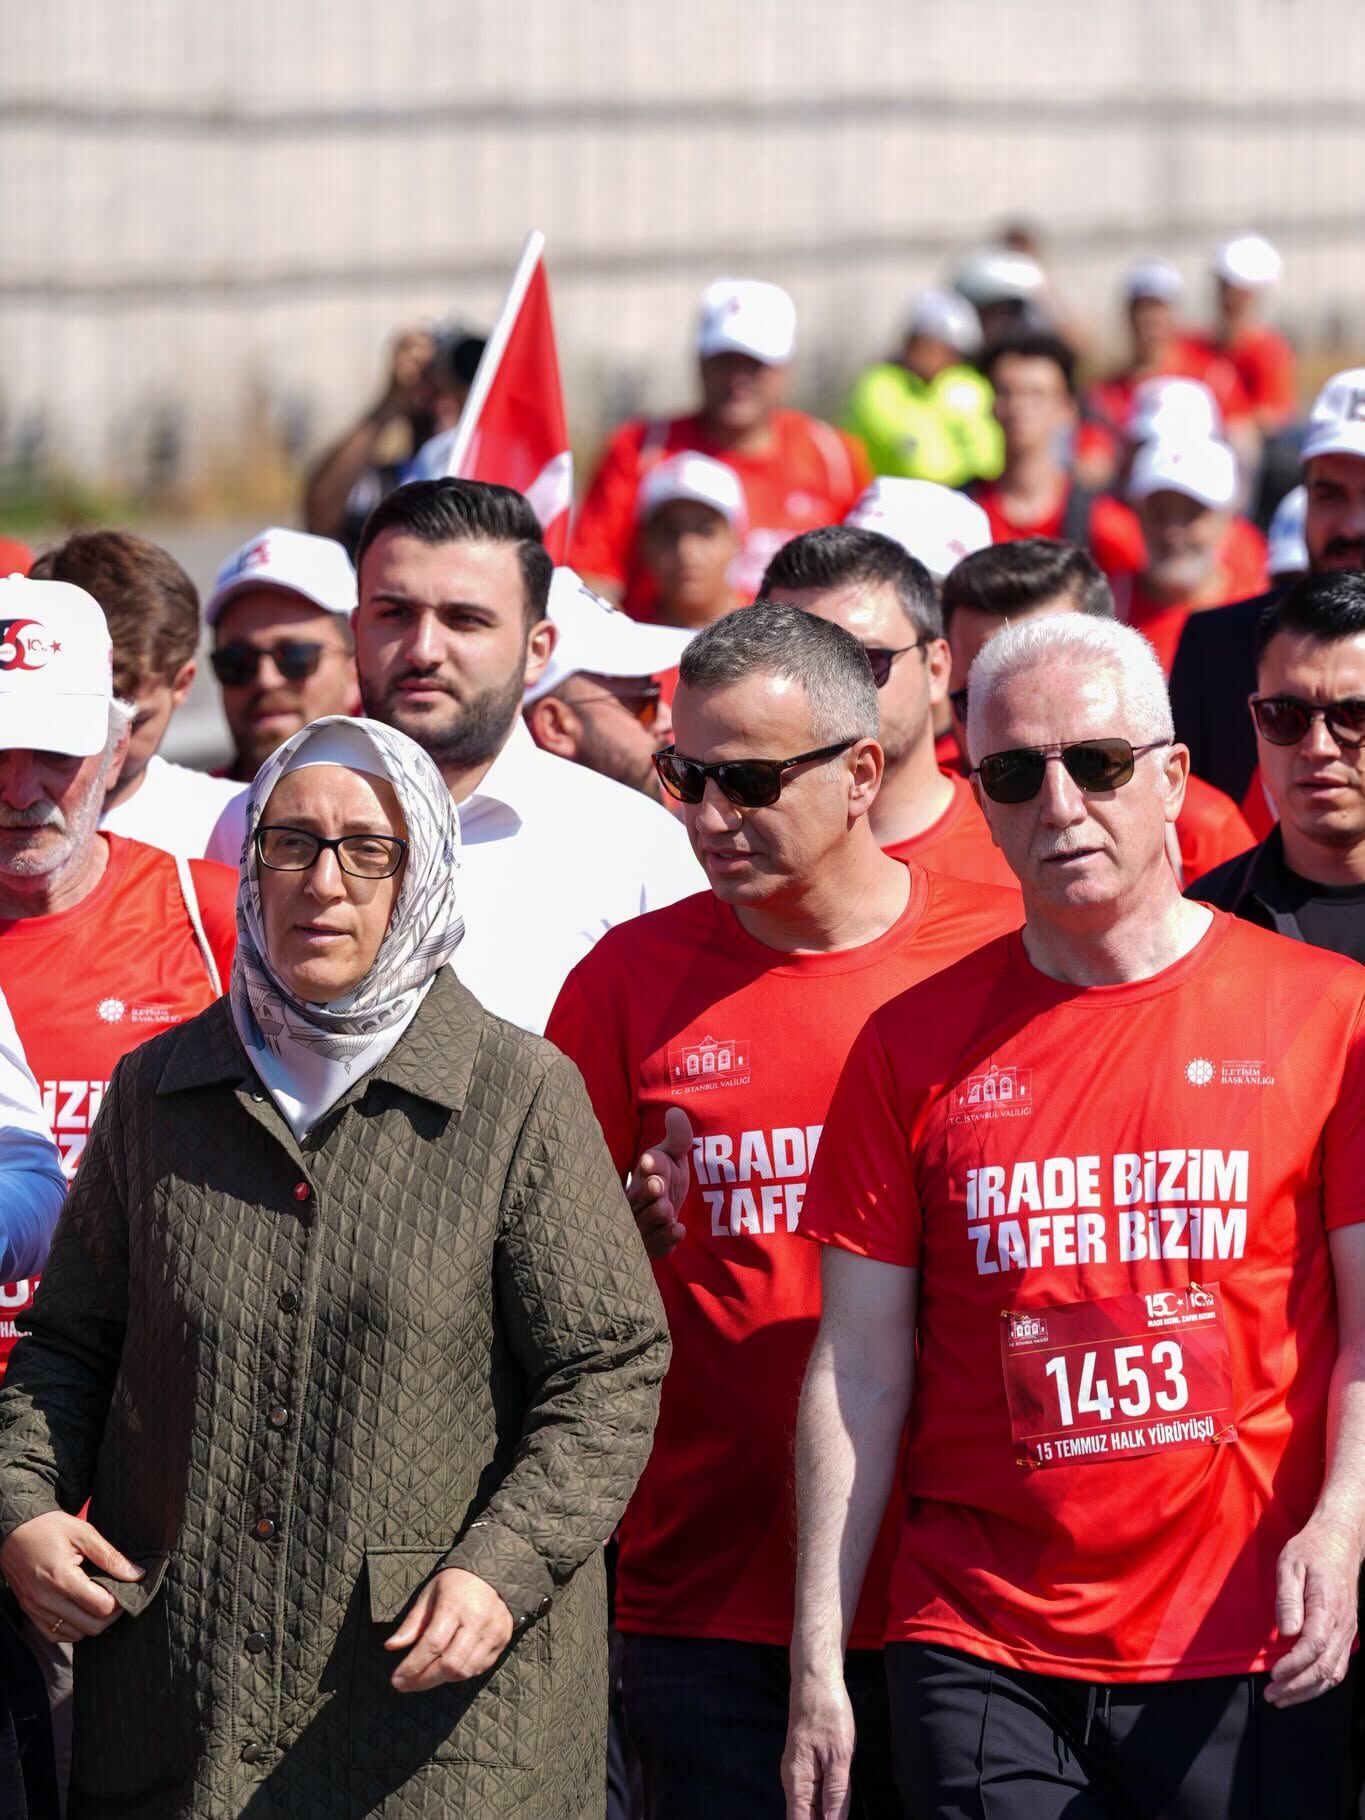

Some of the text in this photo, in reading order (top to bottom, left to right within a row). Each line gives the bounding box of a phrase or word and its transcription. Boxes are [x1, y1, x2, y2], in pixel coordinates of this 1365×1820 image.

[966, 1149, 1249, 1220] İRADE BİZİM
[968, 1207, 1247, 1275] ZAFER BİZİM
[1145, 1292, 1174, 1318] 15
[1045, 1340, 1189, 1426] 1453
[1036, 1416, 1215, 1461] 15 TEMMUZ HALK YÜRÜYÜŞÜ
